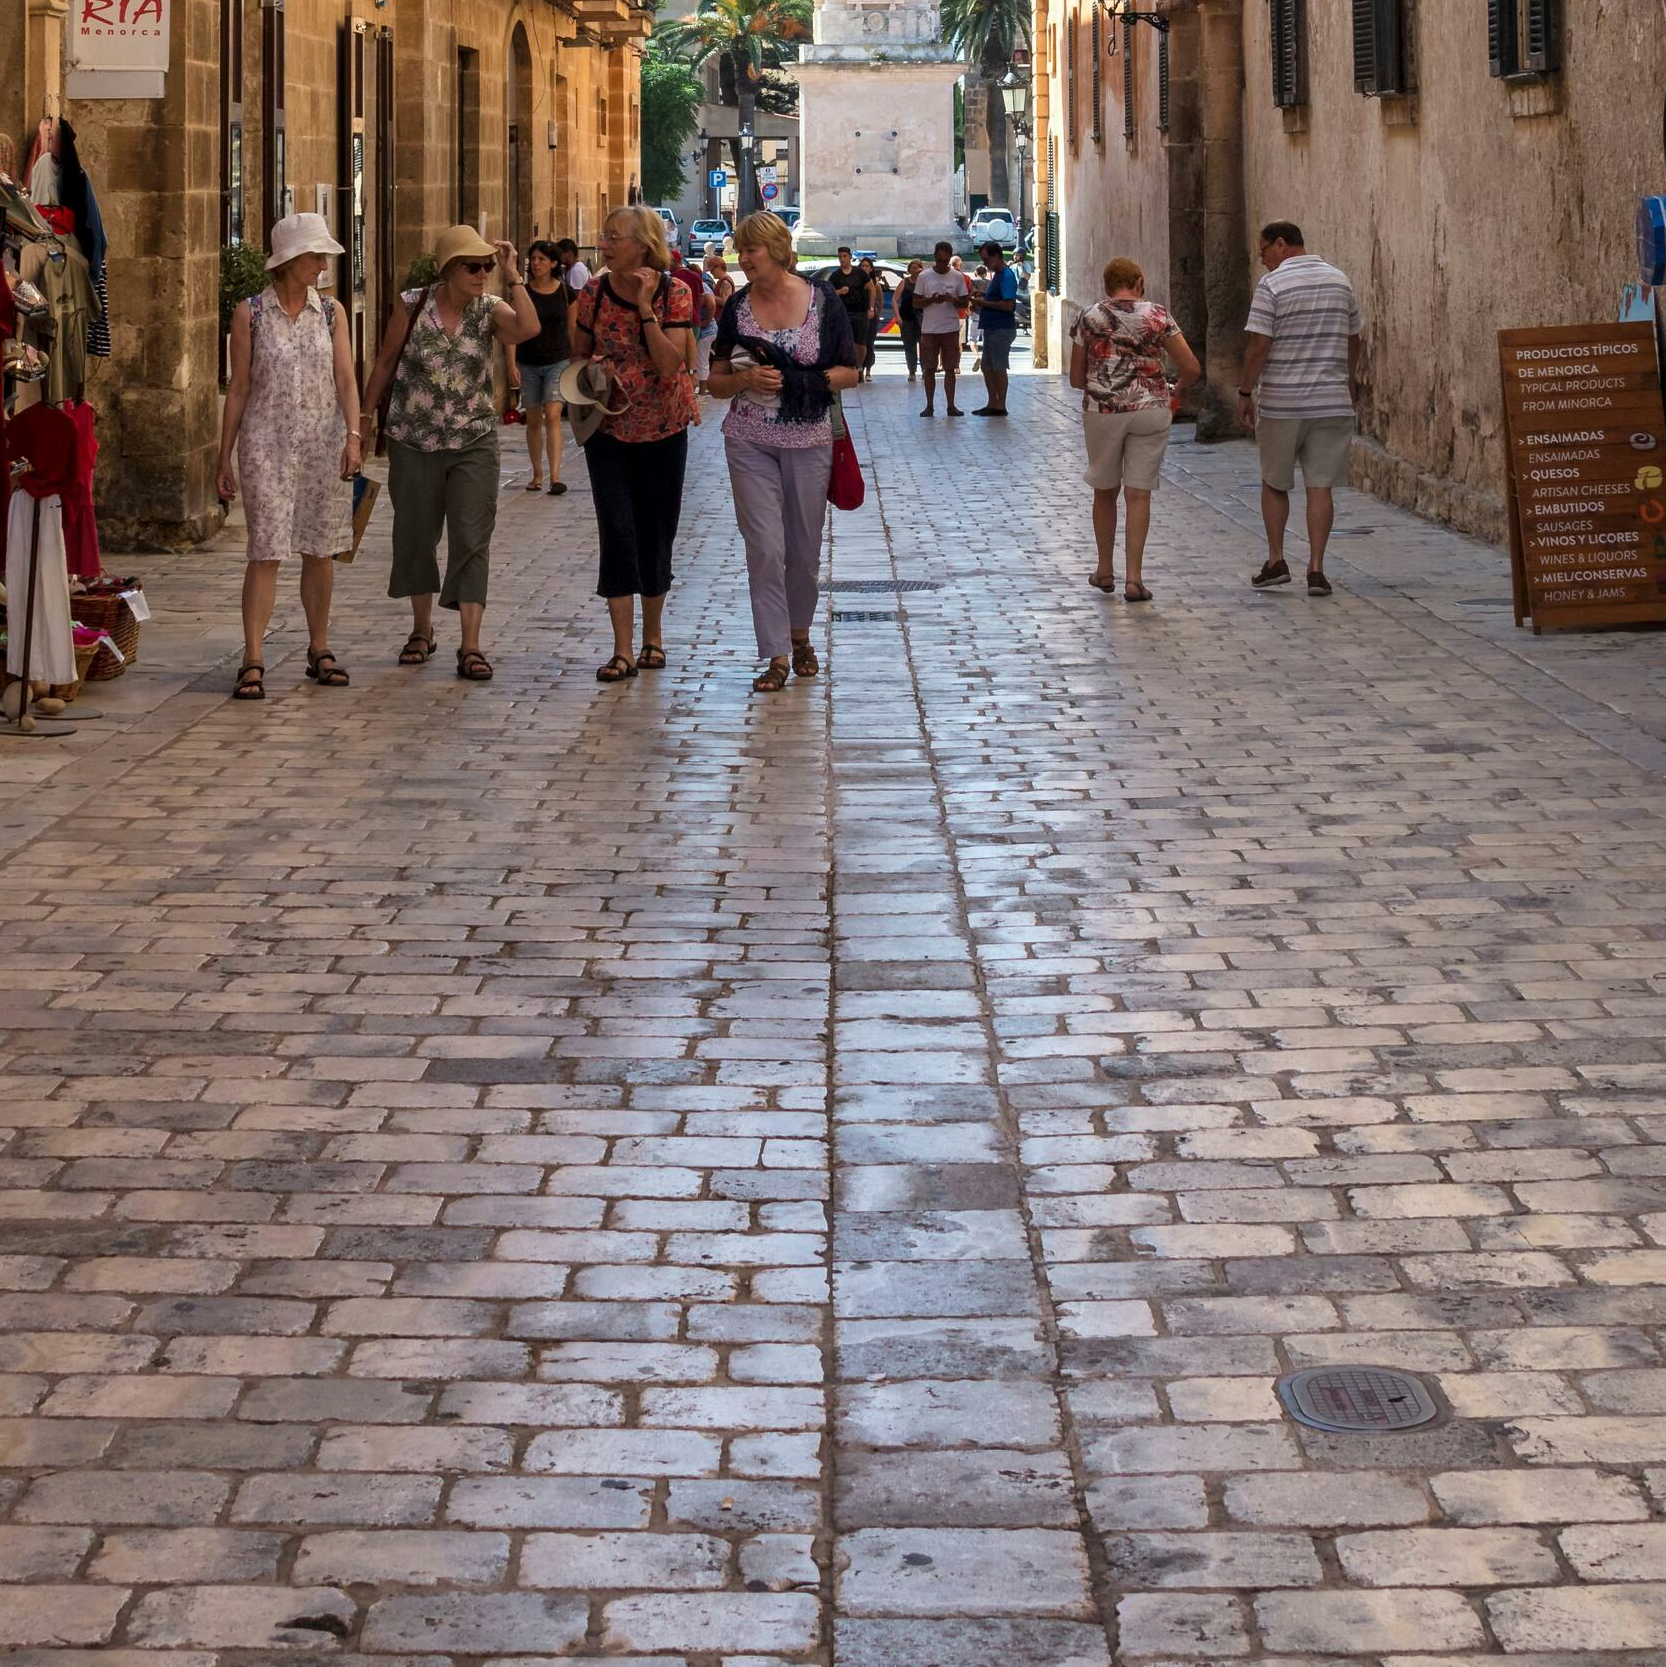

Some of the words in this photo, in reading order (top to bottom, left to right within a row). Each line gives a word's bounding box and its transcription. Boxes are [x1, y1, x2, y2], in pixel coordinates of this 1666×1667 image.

[80, 26, 161, 36] Menorca
[713, 172, 724, 186] P
[1516, 346, 1590, 361] PRODUCTOS
[1591, 343, 1638, 356] TÍPICOS
[1518, 367, 1534, 378] DE
[1537, 364, 1599, 377] MENORCA
[1520, 381, 1564, 394] TYPICAL
[1565, 377, 1626, 391] PRODUCTS
[1522, 400, 1556, 412] FROM
[1558, 397, 1612, 410] MINORCA
[1526, 430, 1605, 446] ENSAIMADAS
[1528, 449, 1601, 464] ENSAIMADAS
[1530, 468, 1580, 482] QUESOS
[1532, 486, 1578, 499] ARTISAN
[1580, 483, 1631, 496] CHEESES
[1534, 501, 1605, 516] EMBUTIDOS
[1536, 520, 1593, 534] SAUSAGES
[1537, 535, 1576, 547] VINOS
[1576, 535, 1586, 545] Y
[1588, 531, 1639, 545] LICORES
[1539, 553, 1575, 566] WINES
[1577, 553, 1586, 564] &
[1588, 550, 1638, 564] LIQUORS
[1542, 567, 1648, 584] MIEL/CONSERVAS
[1543, 589, 1585, 602] HONEY
[1586, 589, 1595, 599] &
[1596, 587, 1627, 600] JAMS
